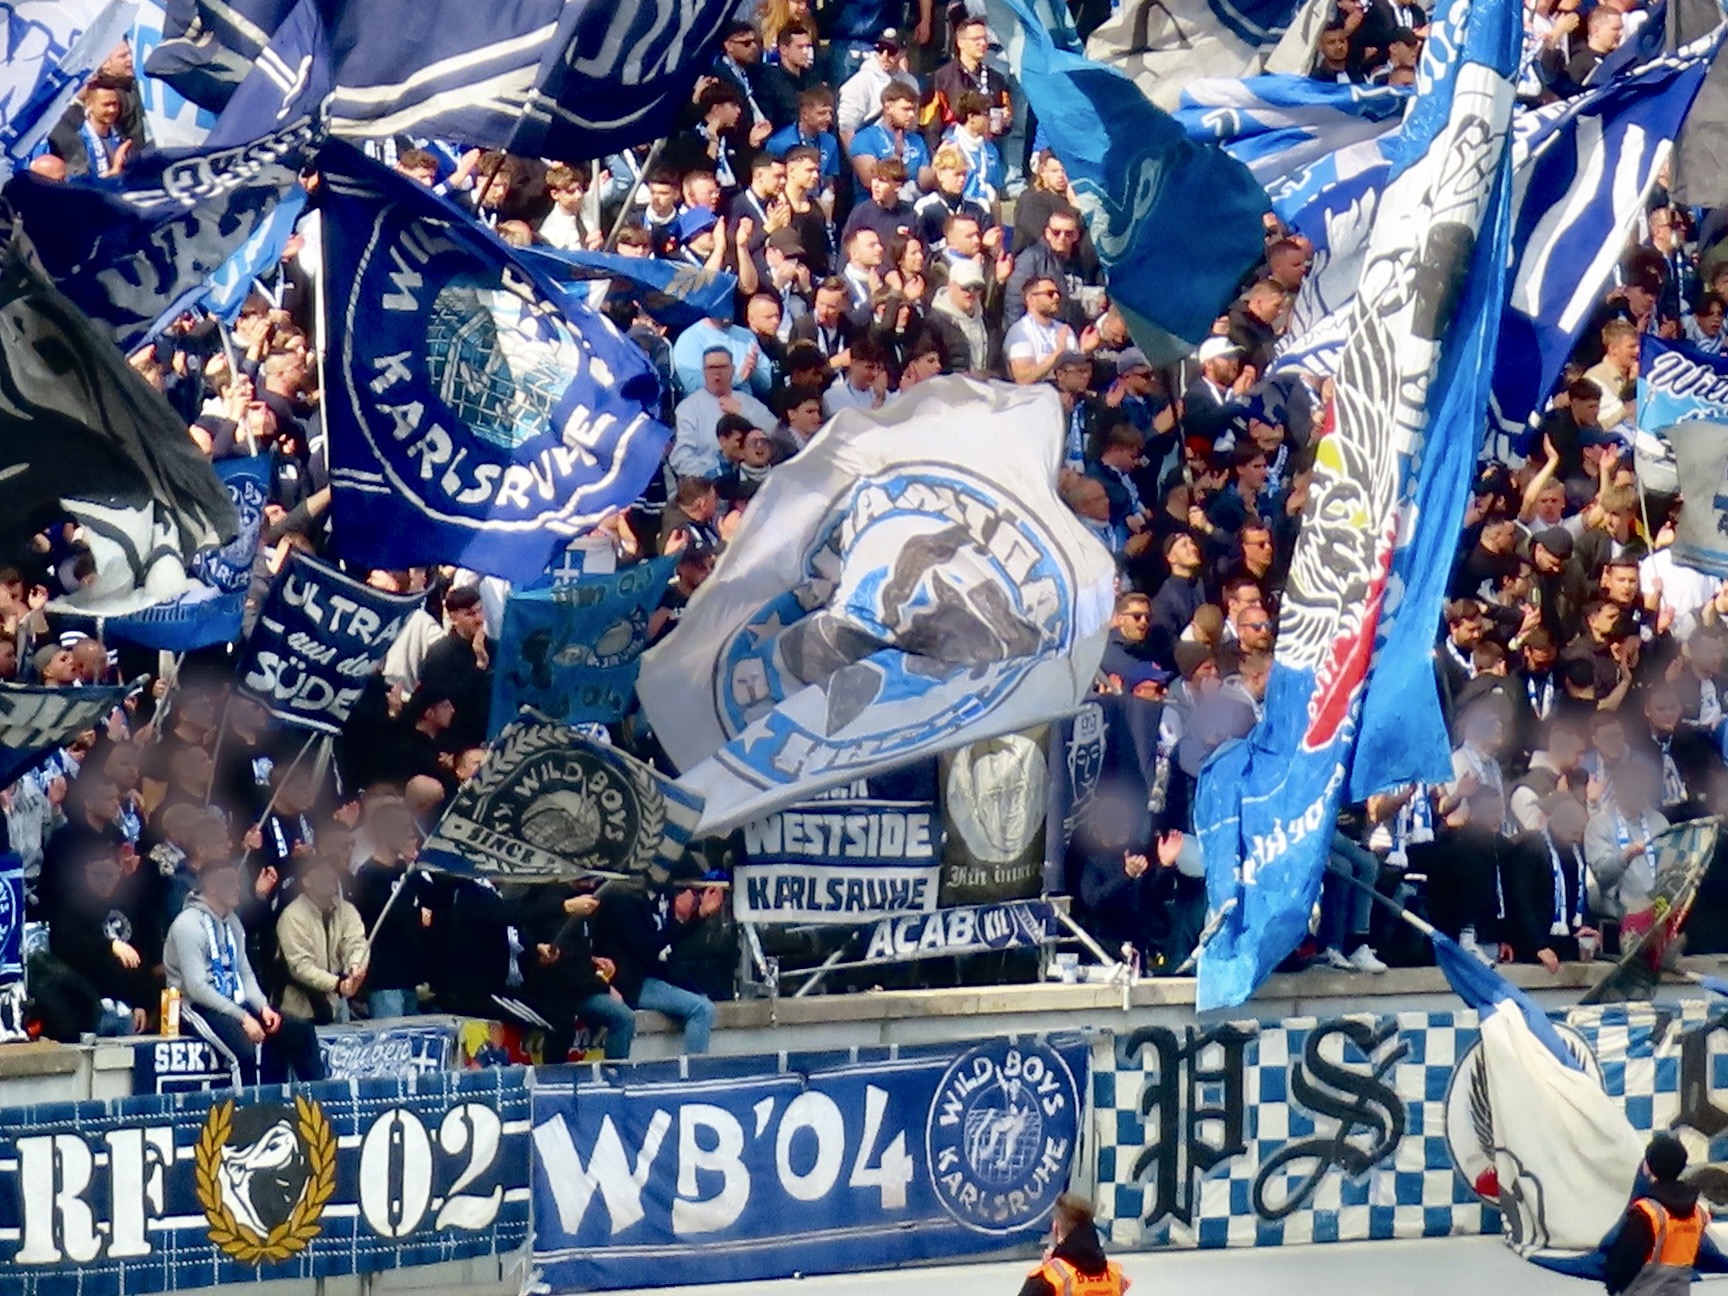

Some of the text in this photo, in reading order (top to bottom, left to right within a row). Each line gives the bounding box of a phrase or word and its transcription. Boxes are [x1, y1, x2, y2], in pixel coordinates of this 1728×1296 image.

[515, 761, 627, 841] WILD BOYS
[744, 813, 934, 856] WESTSIDE
[466, 824, 536, 863] SINCE
[747, 876, 928, 911] KARLSRUHE
[867, 909, 975, 960] ACAB
[940, 1051, 1066, 1127] WILD BOYS
[15, 1104, 504, 1264] RF 02
[532, 1086, 914, 1236] WB'04
[937, 1137, 1068, 1222] KARLSRUHE
